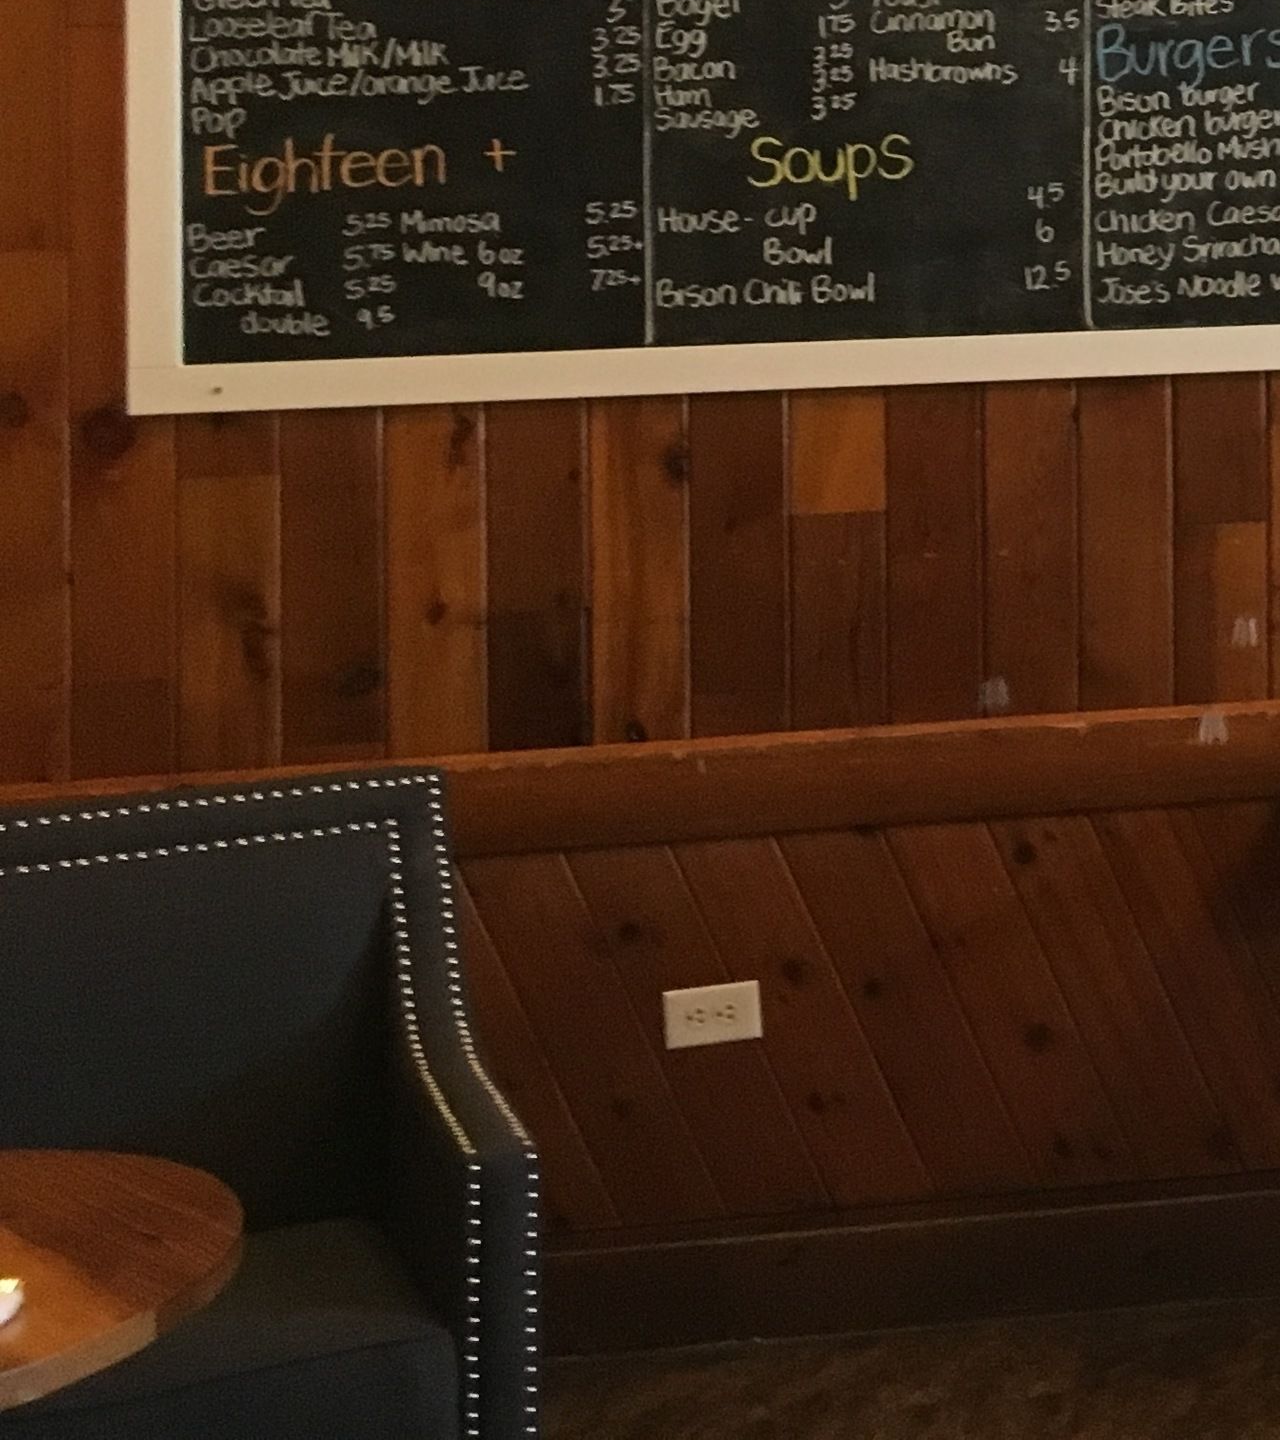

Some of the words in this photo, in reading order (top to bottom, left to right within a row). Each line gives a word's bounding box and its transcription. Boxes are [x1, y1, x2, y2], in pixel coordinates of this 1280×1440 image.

[315, 11, 378, 40] Tea
[869, 8, 996, 35] Cinnamon
[654, 21, 709, 57] Egg
[946, 32, 996, 54] Bun
[654, 58, 737, 82] Bacon
[1059, 57, 1079, 86] 4
[191, 72, 274, 105] Apple
[654, 84, 712, 107] Ham
[1097, 86, 1170, 117] Bison
[1179, 81, 1260, 108] burger
[191, 107, 247, 138] Pop
[654, 107, 760, 139] Sausage
[1098, 116, 1197, 145] Chicken
[203, 133, 446, 216] Eighteen
[748, 134, 915, 201] Soups
[1095, 172, 1158, 200] Build
[1159, 171, 1217, 203] your
[400, 210, 500, 233] Mimosa
[1035, 219, 1055, 242] 6
[1095, 210, 1195, 234] Chicken
[187, 224, 266, 252] Beer
[763, 237, 833, 265] Bowl
[190, 254, 294, 278] Caesar
[402, 242, 469, 265] Wine
[1097, 242, 1175, 271] Honey
[655, 278, 737, 309] Bison
[811, 272, 875, 303] Bowl
[1177, 271, 1262, 296] Noodle
[240, 312, 331, 337] double
